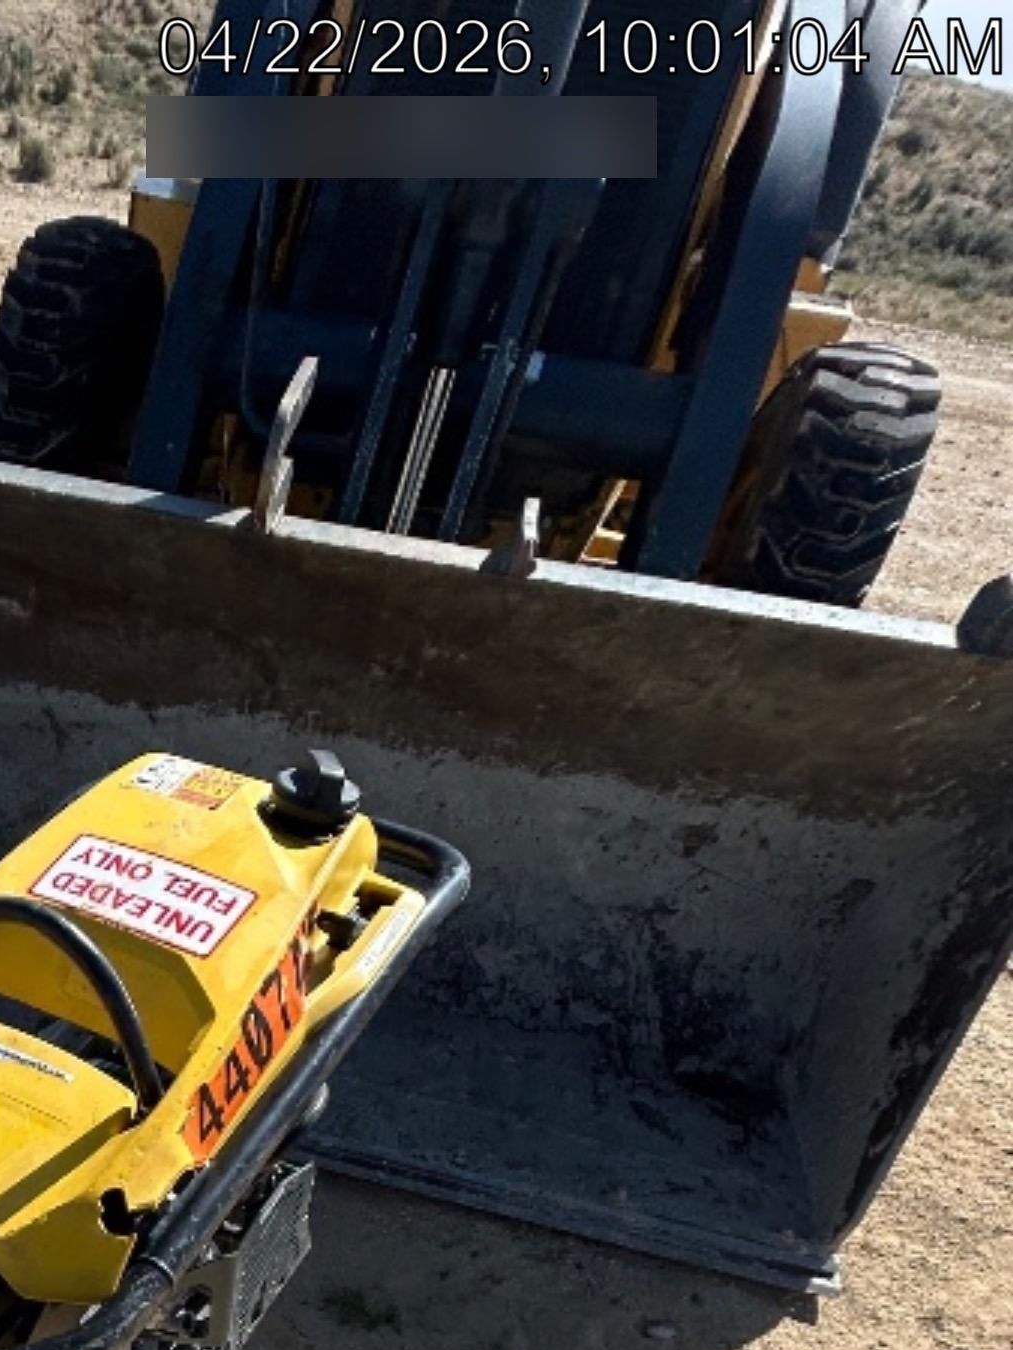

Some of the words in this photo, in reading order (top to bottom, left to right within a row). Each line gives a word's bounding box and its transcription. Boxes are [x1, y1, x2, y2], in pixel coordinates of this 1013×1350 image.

[70, 846, 153, 880] ONLY
[51, 871, 214, 943] UNLEADED
[162, 872, 238, 916] FUEL
